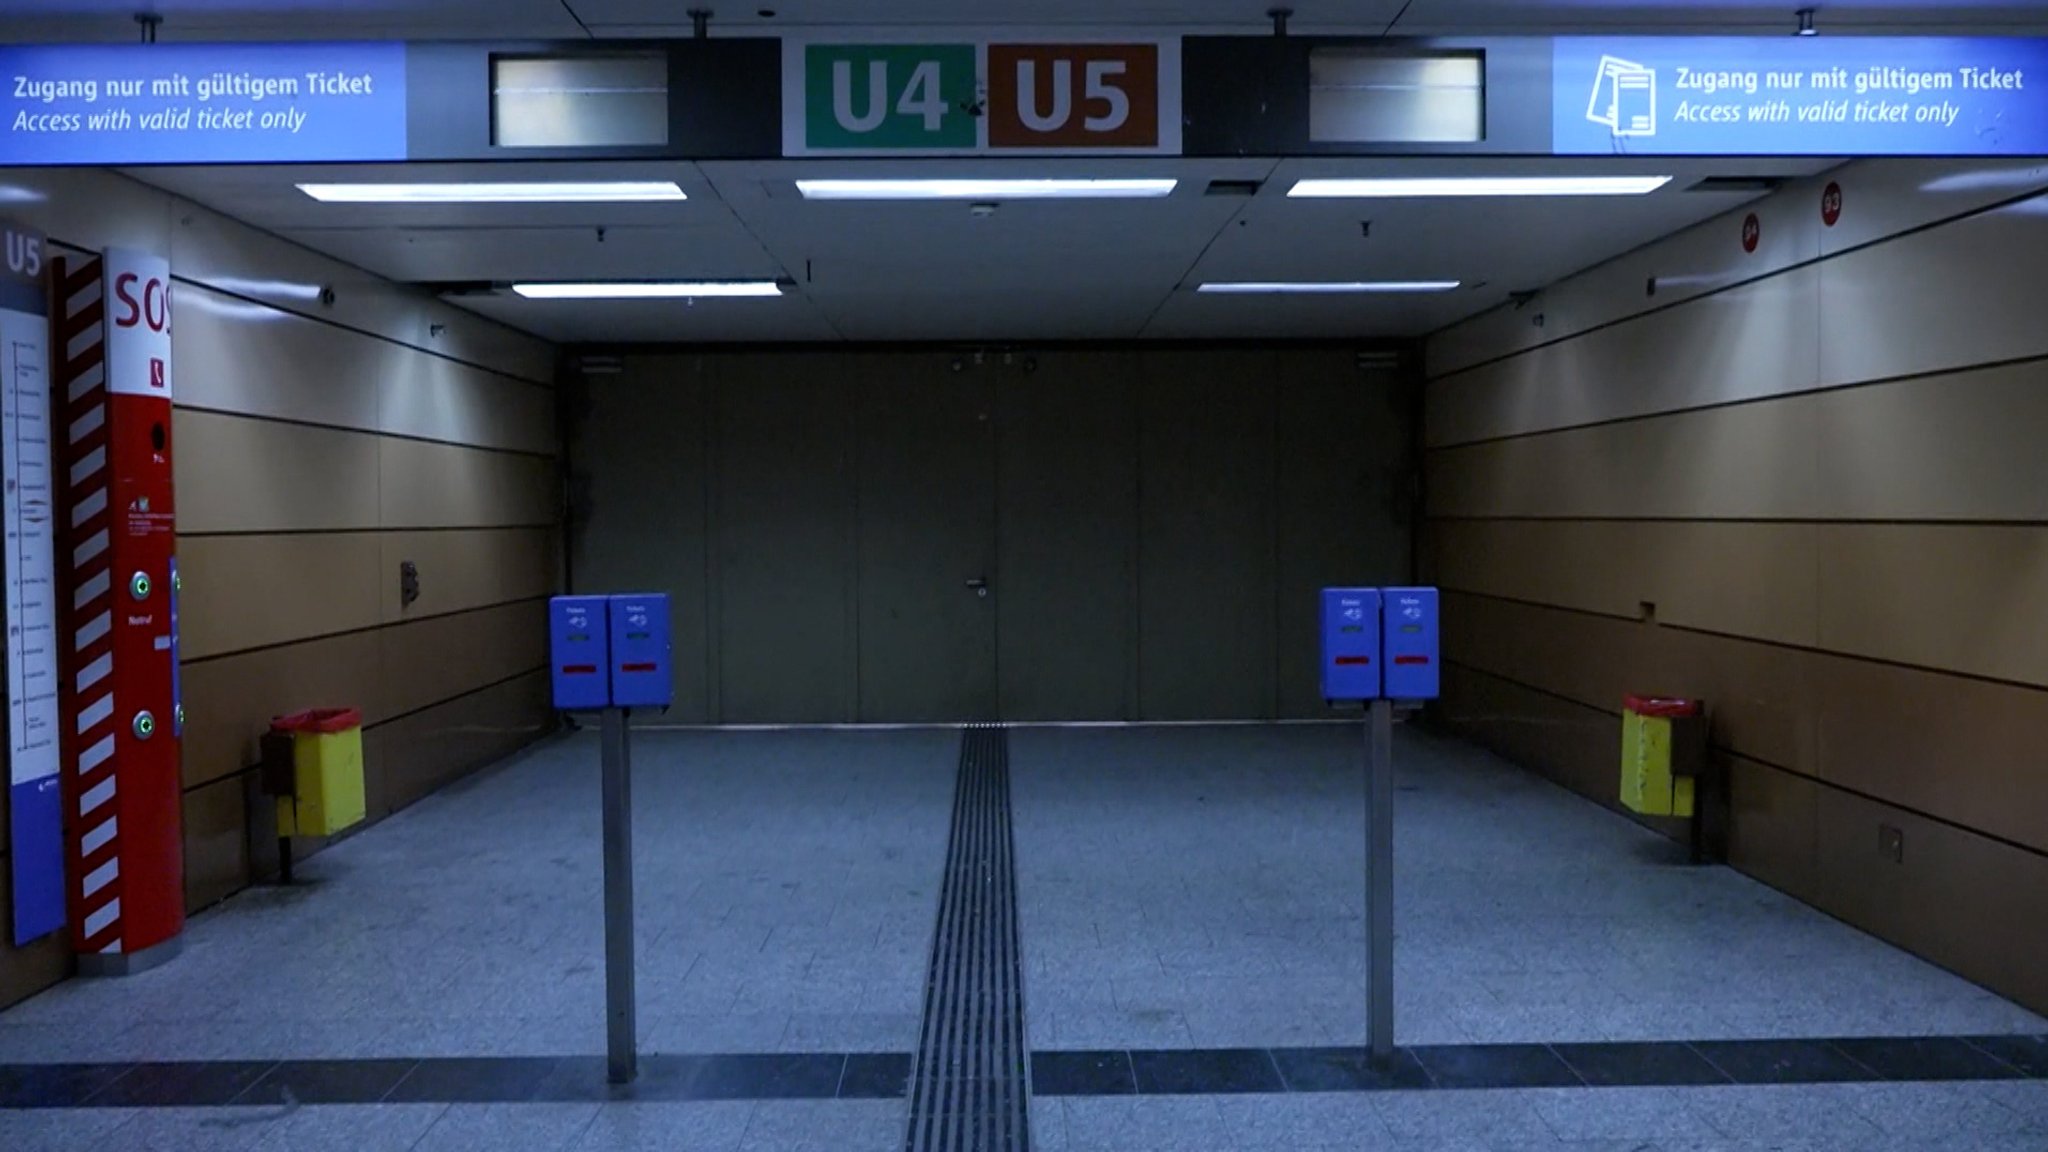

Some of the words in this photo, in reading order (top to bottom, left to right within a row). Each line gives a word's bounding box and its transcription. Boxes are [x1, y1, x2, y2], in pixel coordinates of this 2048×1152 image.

[13, 76, 97, 103] Zugang
[106, 79, 144, 96] nur
[152, 73, 189, 96] mit
[197, 73, 298, 101] gültigem
[305, 72, 372, 95] Ticket
[833, 60, 949, 133] U4
[1016, 59, 1130, 133] U5
[1675, 66, 1757, 94] Zugang
[1766, 72, 1803, 89] nur
[1811, 66, 1848, 89] mit
[1855, 66, 1953, 94] gültigem
[1959, 66, 2023, 89] Ticket
[12, 110, 81, 131] Access
[88, 108, 131, 130] with
[139, 107, 191, 130] valid
[197, 107, 253, 129] ticket
[260, 106, 306, 133] only
[1673, 100, 1741, 122] Access
[1748, 99, 1790, 122] with
[1798, 99, 1848, 122] valid
[1854, 100, 1909, 122] ticket
[1915, 100, 1960, 127] only
[6, 231, 41, 277] U5
[115, 272, 170, 334] SO
